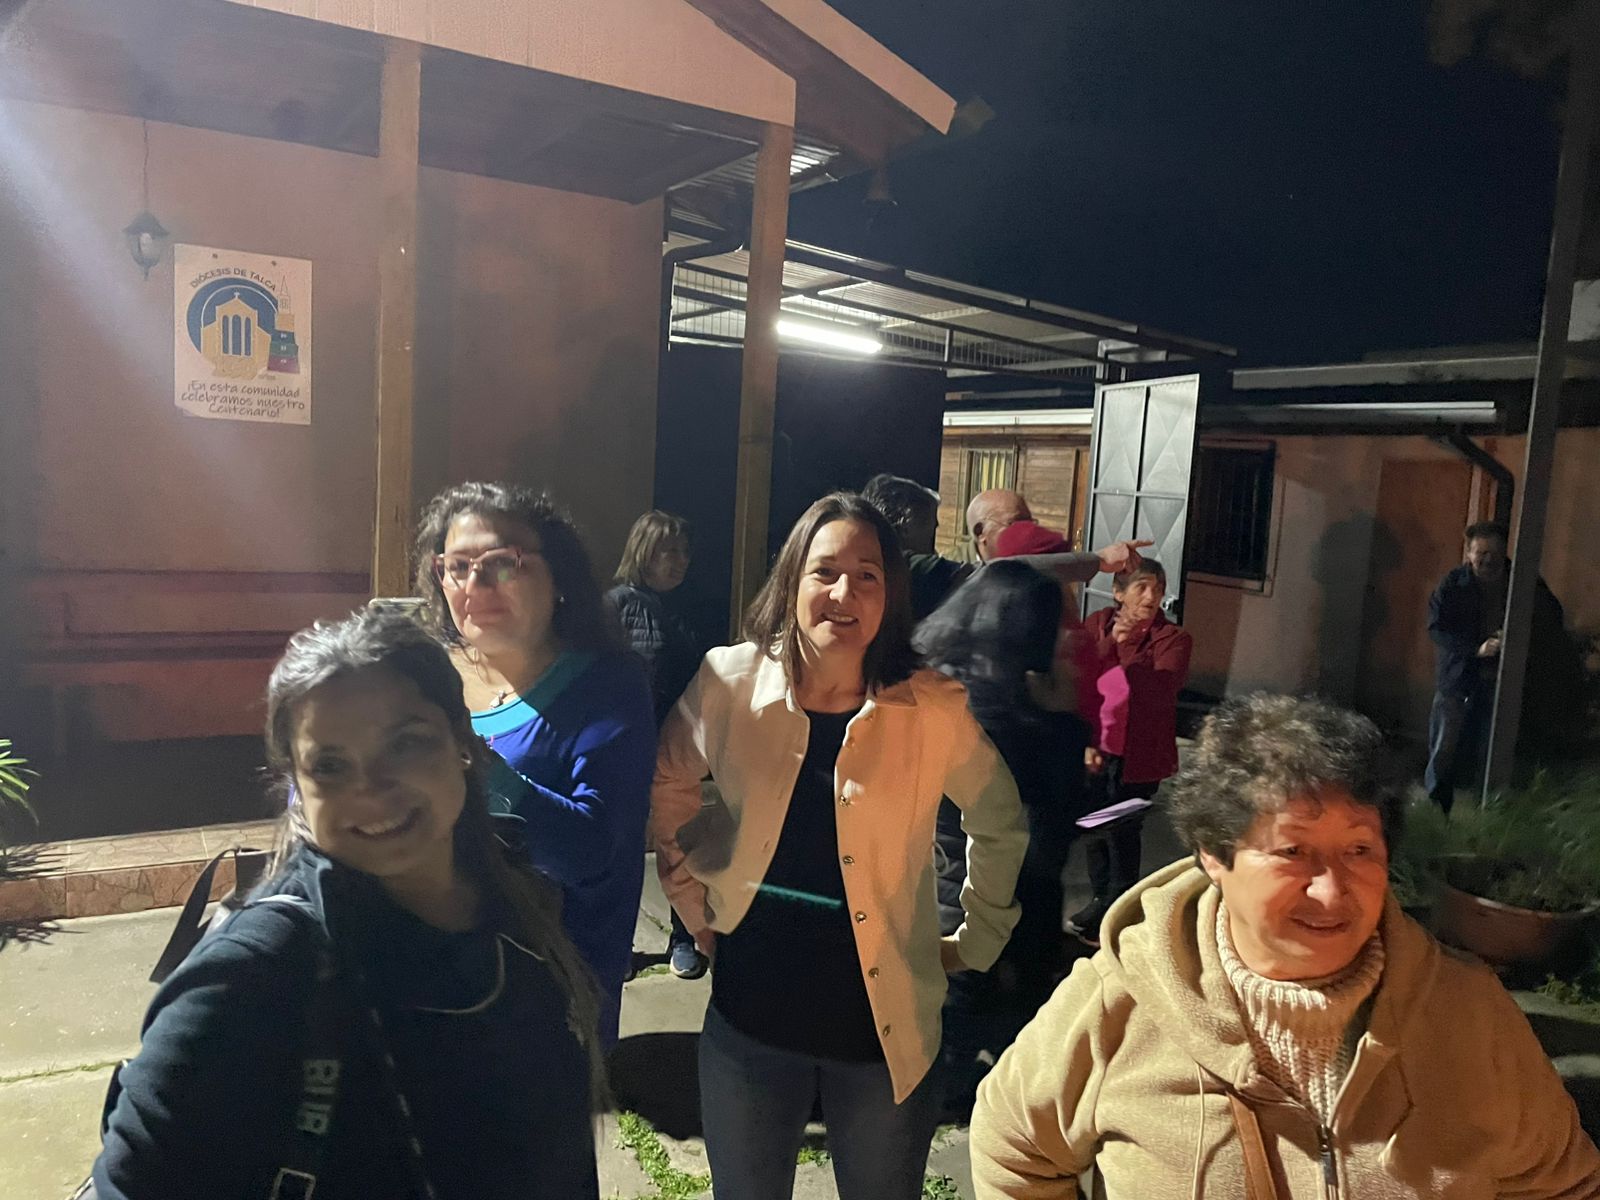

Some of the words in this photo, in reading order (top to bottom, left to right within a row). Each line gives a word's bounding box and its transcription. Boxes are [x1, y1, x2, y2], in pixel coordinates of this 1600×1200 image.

[233, 267, 247, 277] DE
[250, 271, 276, 291] TALCA
[209, 382, 238, 393] esta
[241, 385, 300, 398] comunidad
[256, 398, 305, 410] nuestro
